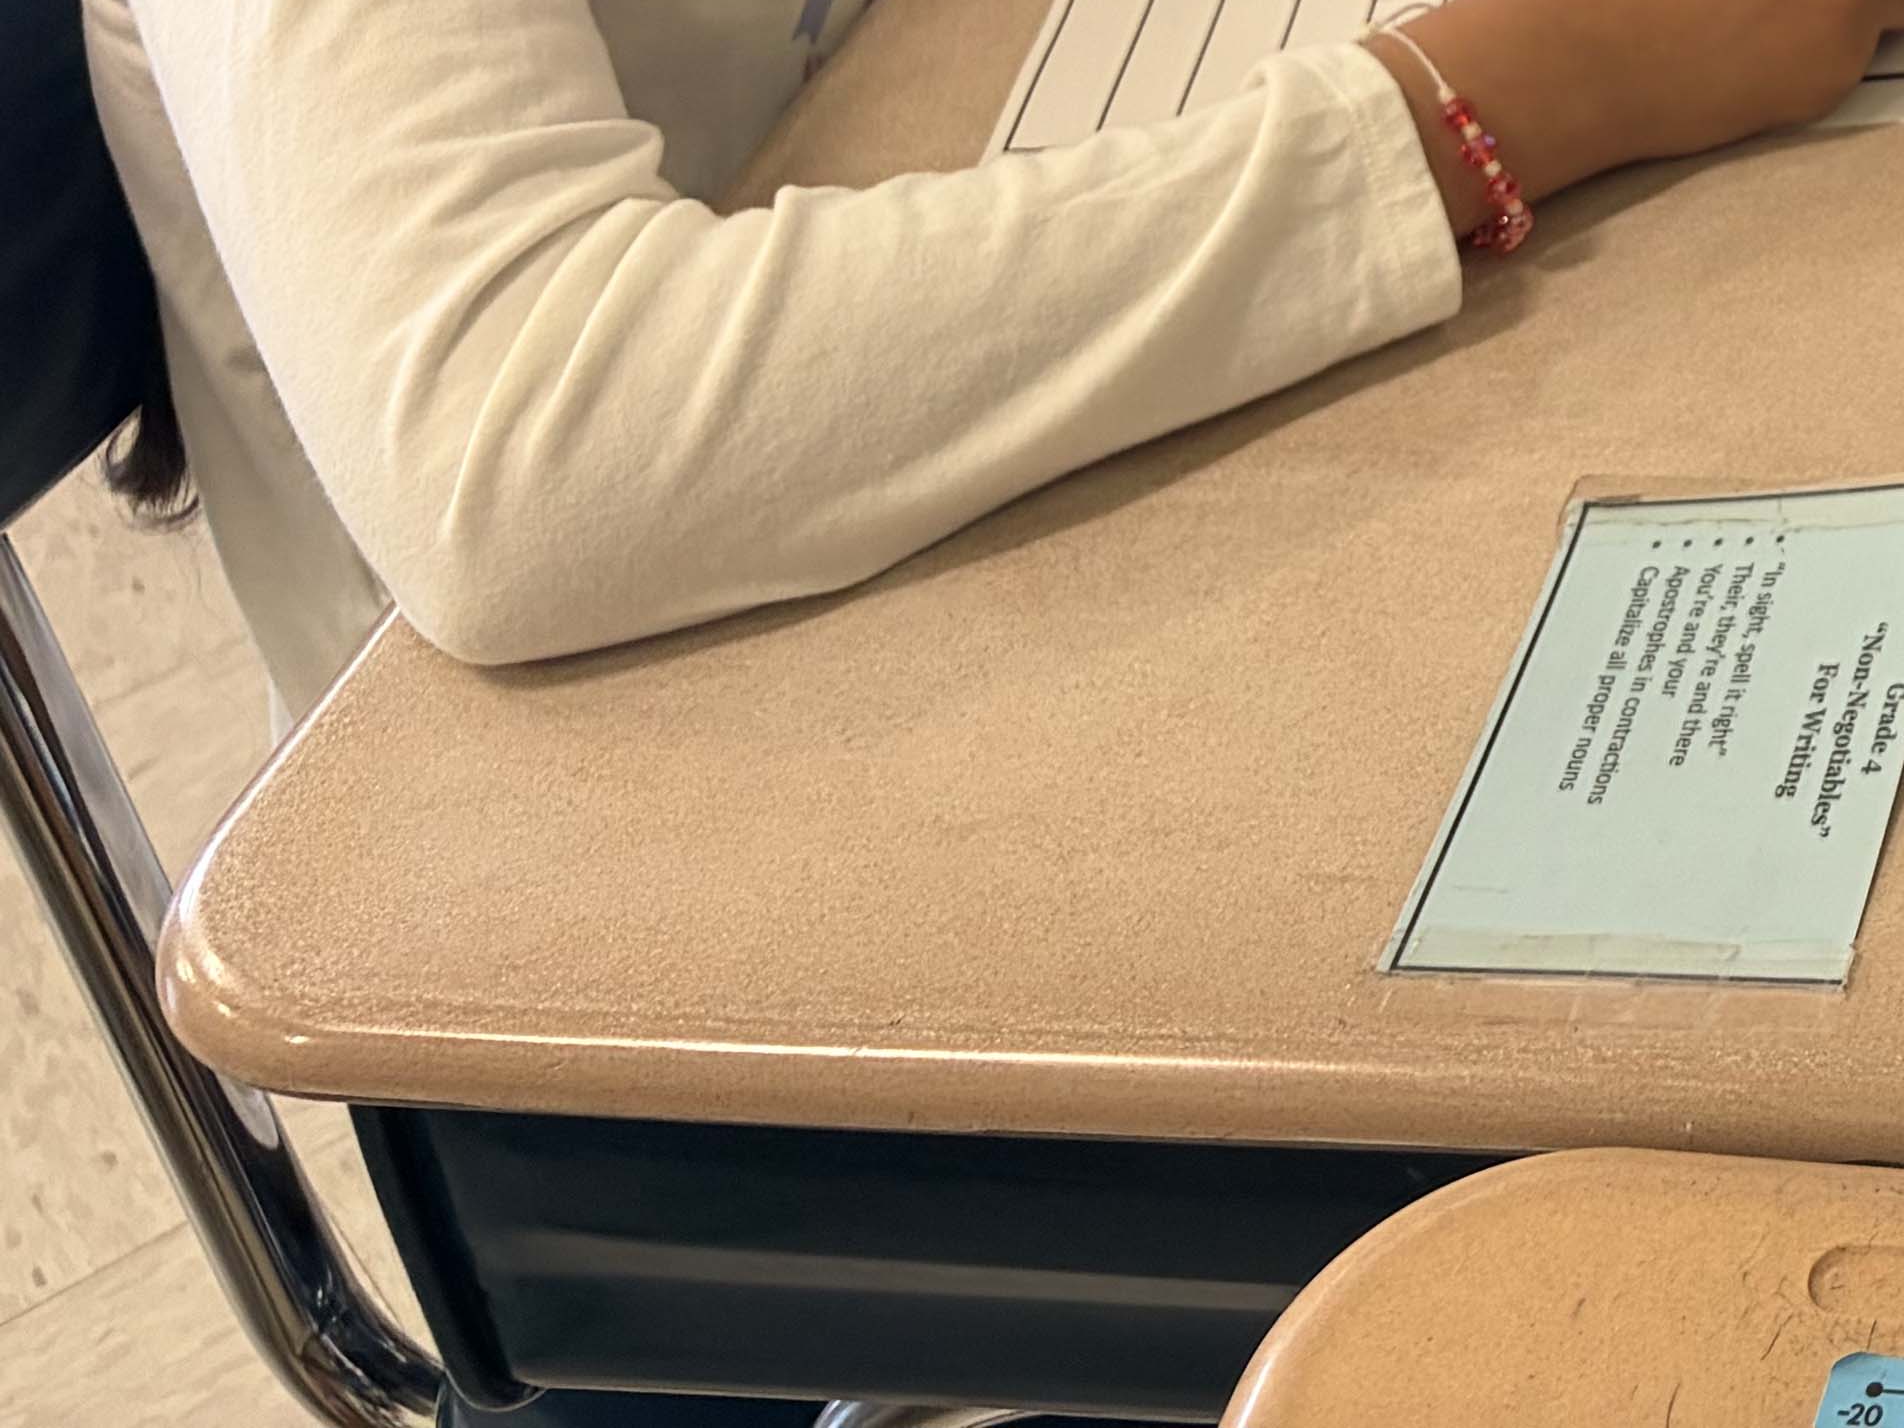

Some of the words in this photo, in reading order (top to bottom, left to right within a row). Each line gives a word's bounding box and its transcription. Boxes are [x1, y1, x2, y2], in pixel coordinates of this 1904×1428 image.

[1687, 563, 1723, 618] You’re
[1719, 561, 1754, 610] Their,
[1760, 561, 1786, 587] “In
[1613, 565, 1660, 647] Capitalize
[1636, 565, 1690, 672] Apostrophes
[1741, 591, 1774, 639] sight,
[1605, 650, 1627, 670] all
[1675, 621, 1700, 654] and
[1629, 676, 1653, 692] in
[1660, 657, 1687, 698] your
[1729, 642, 1756, 683] spell
[1809, 662, 1840, 704] For
[1581, 674, 1616, 733] proper
[1686, 680, 1711, 714] and
[1723, 688, 1746, 701] it
[1586, 696, 1640, 804] contractions
[1668, 718, 1702, 766] there
[1707, 705, 1735, 756] right”
[1774, 709, 1827, 798] Writing
[1810, 621, 1888, 838] “Non-Negotiables”
[1557, 737, 1592, 791] nouns
[1860, 758, 1882, 775] 4
[1837, 1402, 1884, 1428] -20
